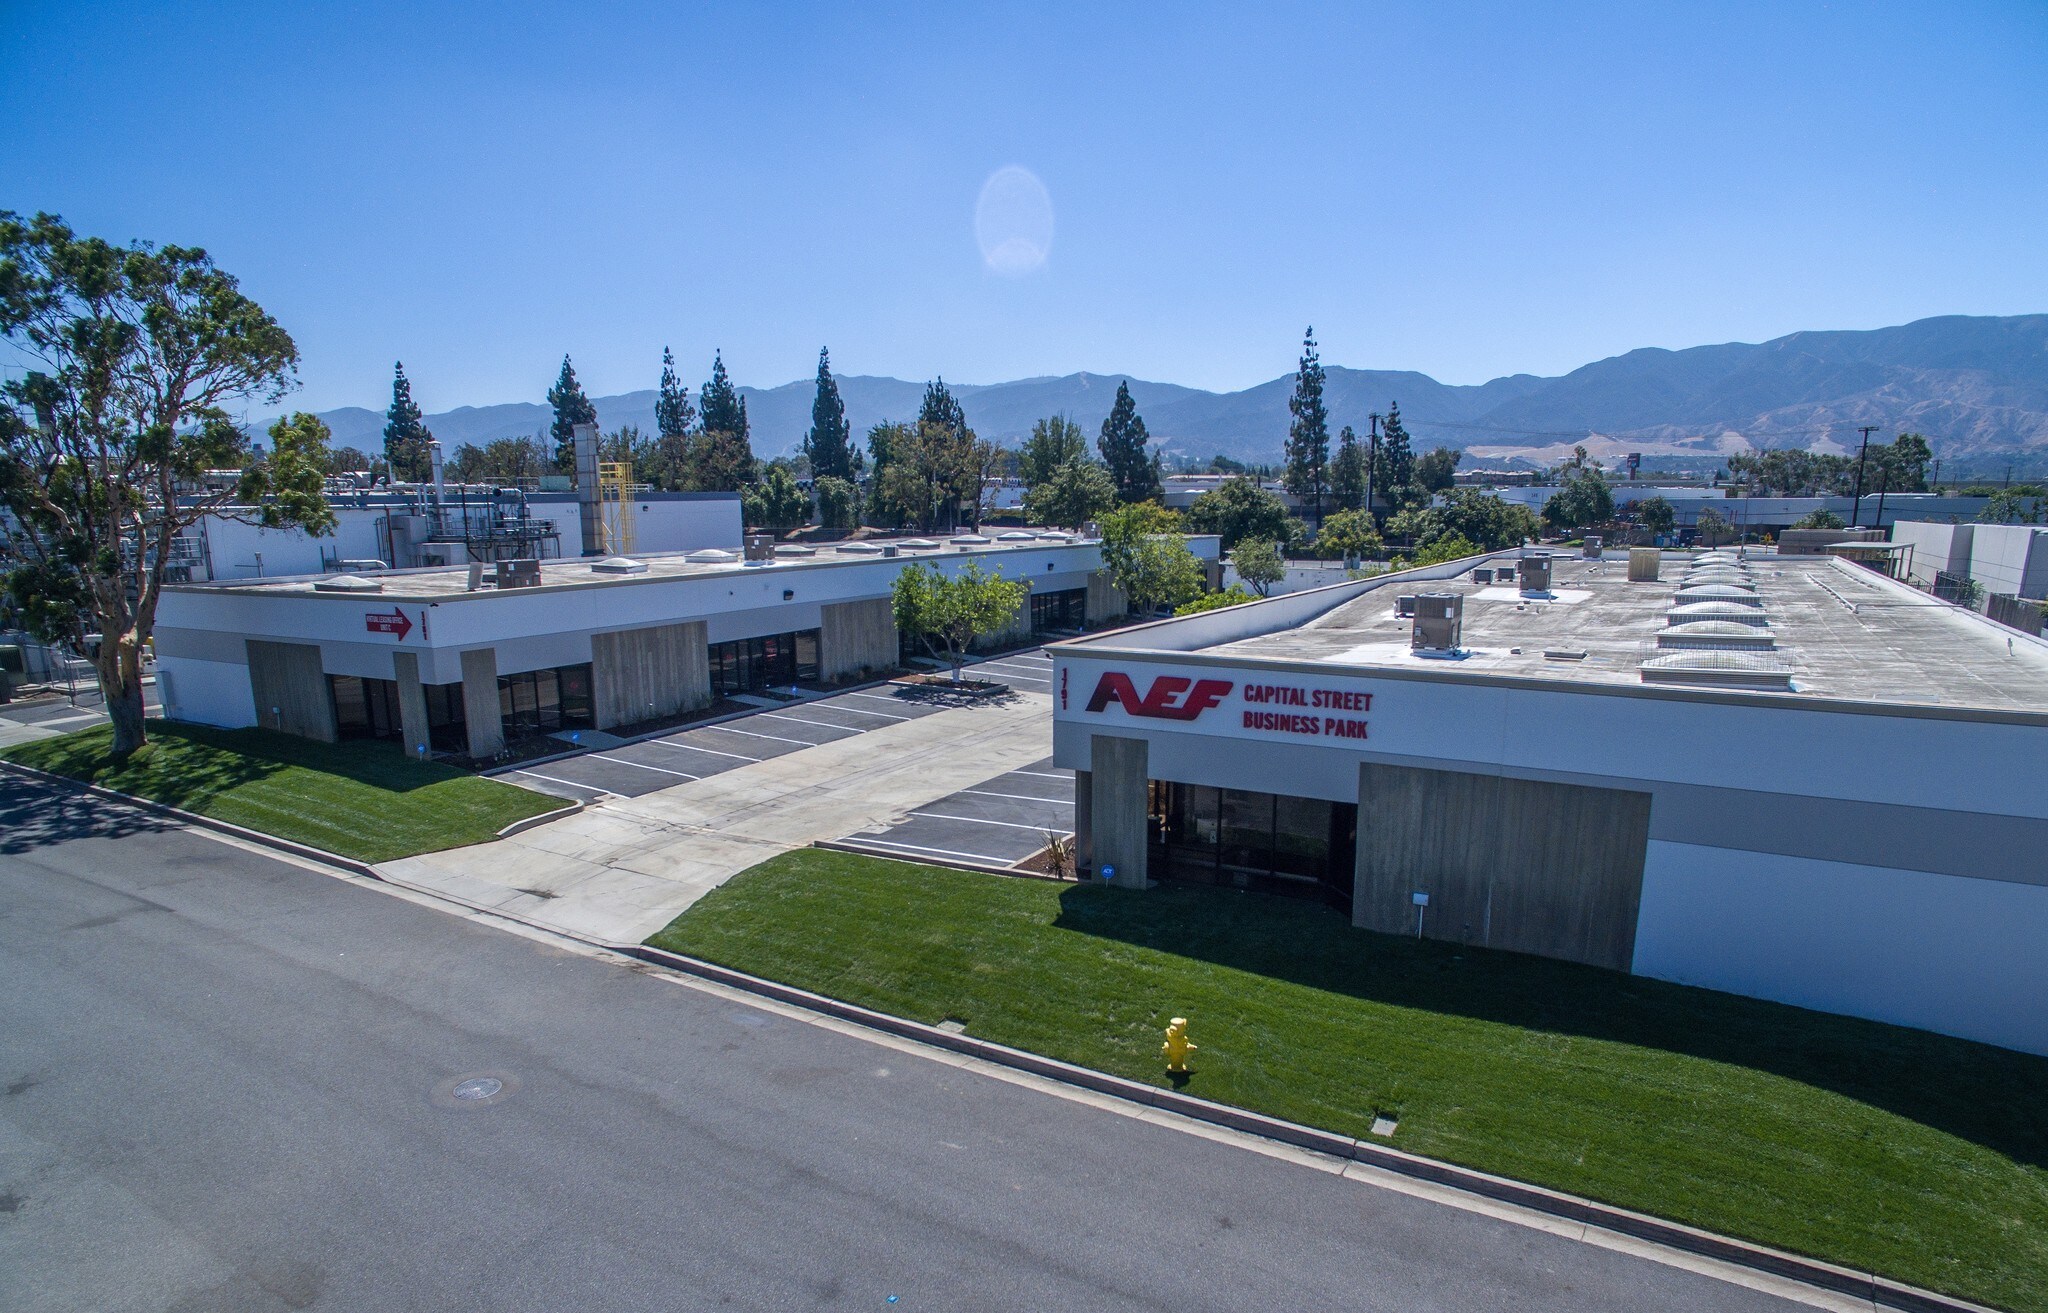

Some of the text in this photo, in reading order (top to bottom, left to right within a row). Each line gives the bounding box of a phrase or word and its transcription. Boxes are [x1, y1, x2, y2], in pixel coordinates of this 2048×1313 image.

[1243, 684, 1373, 711] CAPITAL STREET
[1243, 711, 1368, 739] BUSINESS PARK
